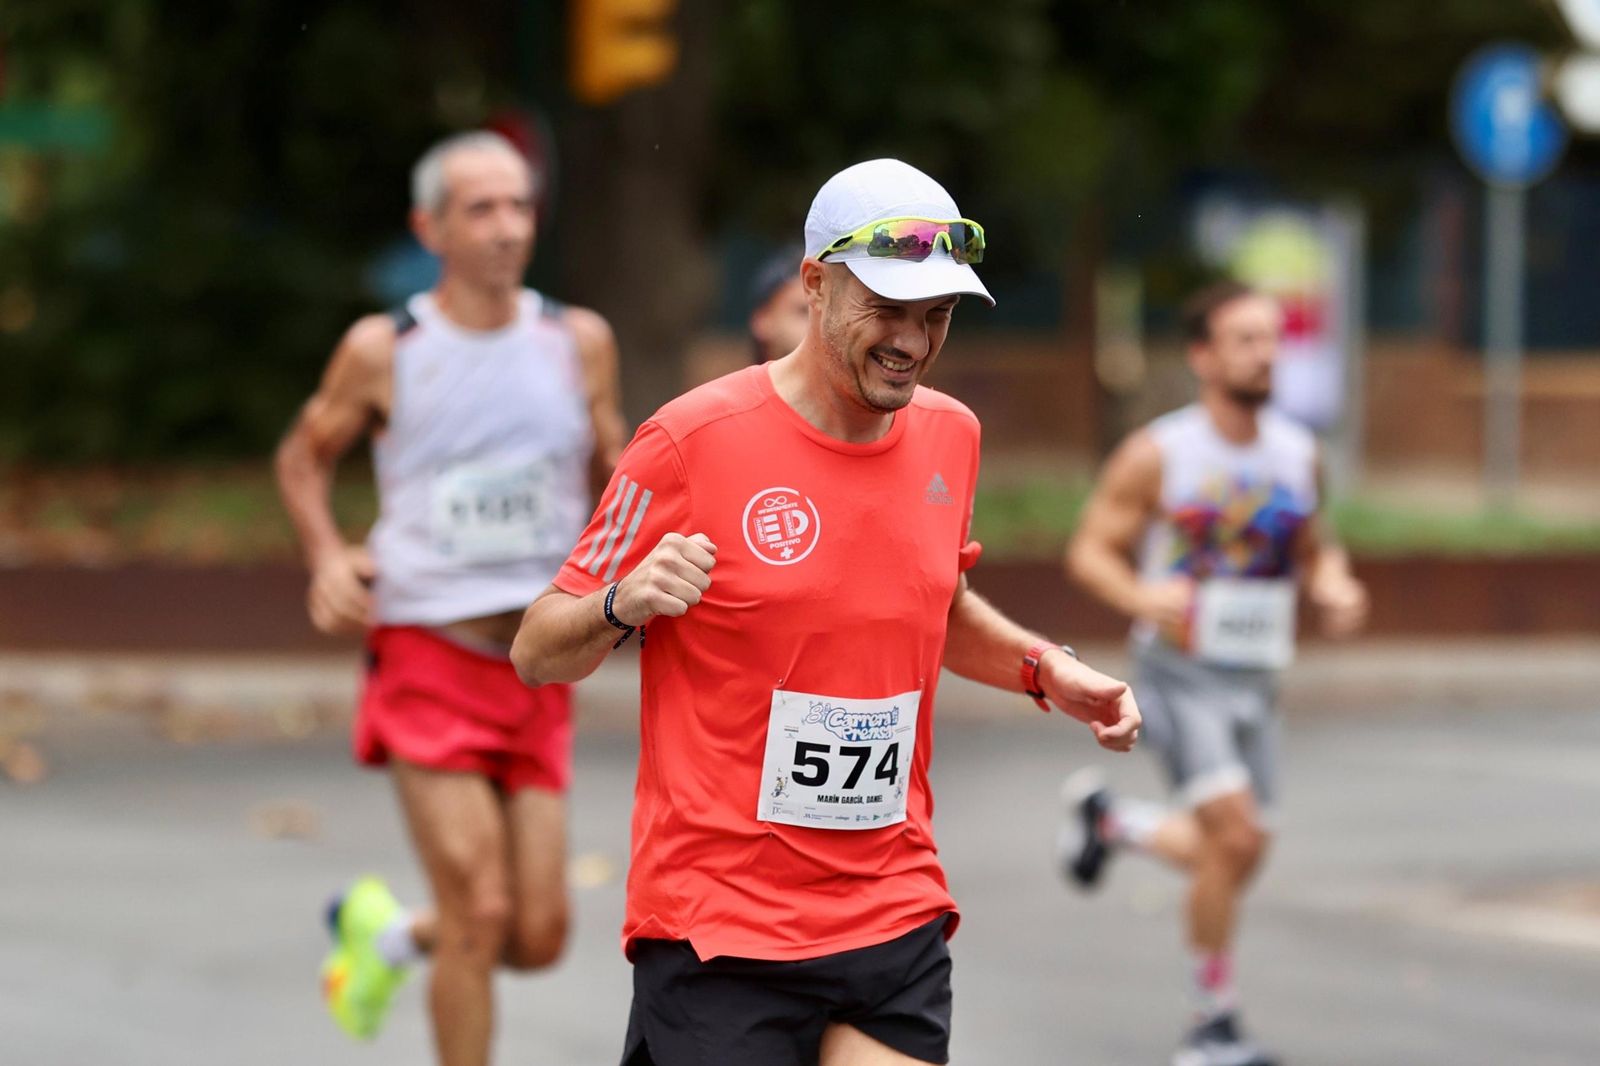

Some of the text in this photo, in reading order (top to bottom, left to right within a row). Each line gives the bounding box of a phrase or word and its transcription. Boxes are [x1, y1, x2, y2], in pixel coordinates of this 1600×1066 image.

[769, 537, 801, 550] POSITIVO
[828, 707, 892, 728] Carrera
[842, 726, 893, 741] Prensa
[791, 740, 899, 790] 574
[817, 793, 840, 804] MARÍN
[841, 794, 865, 805] GARCÍA,
